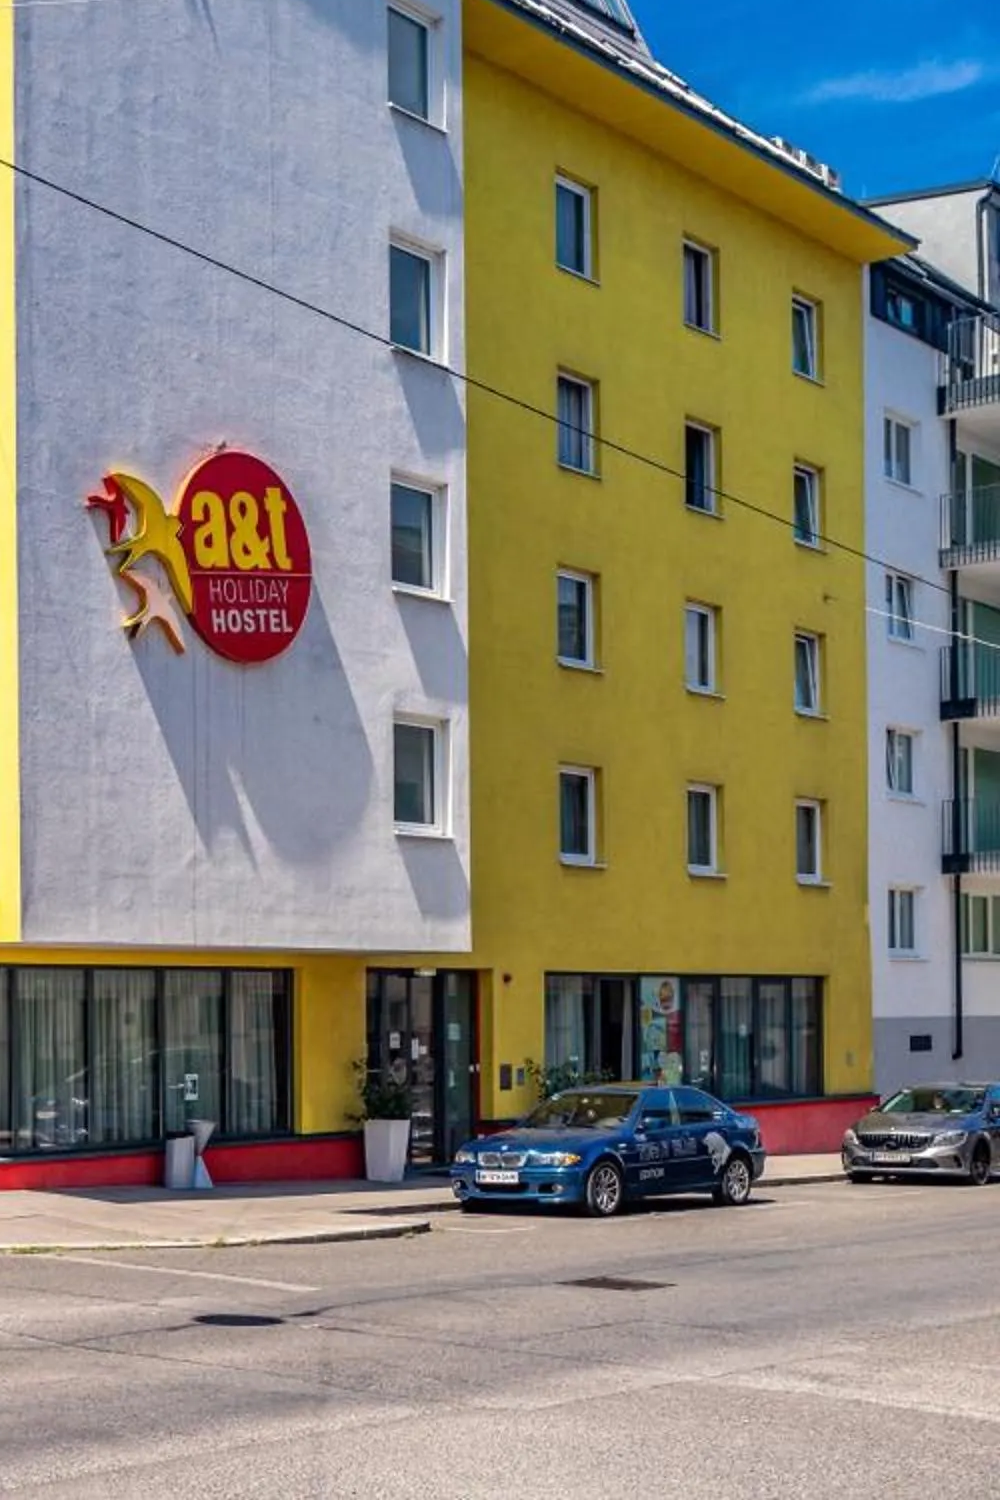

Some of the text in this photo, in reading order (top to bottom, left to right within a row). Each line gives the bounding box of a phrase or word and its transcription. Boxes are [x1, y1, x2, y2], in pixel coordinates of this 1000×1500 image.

[191, 487, 292, 570] a&t
[209, 579, 289, 604] HOLIDAY
[211, 608, 293, 633] HOSTEL
